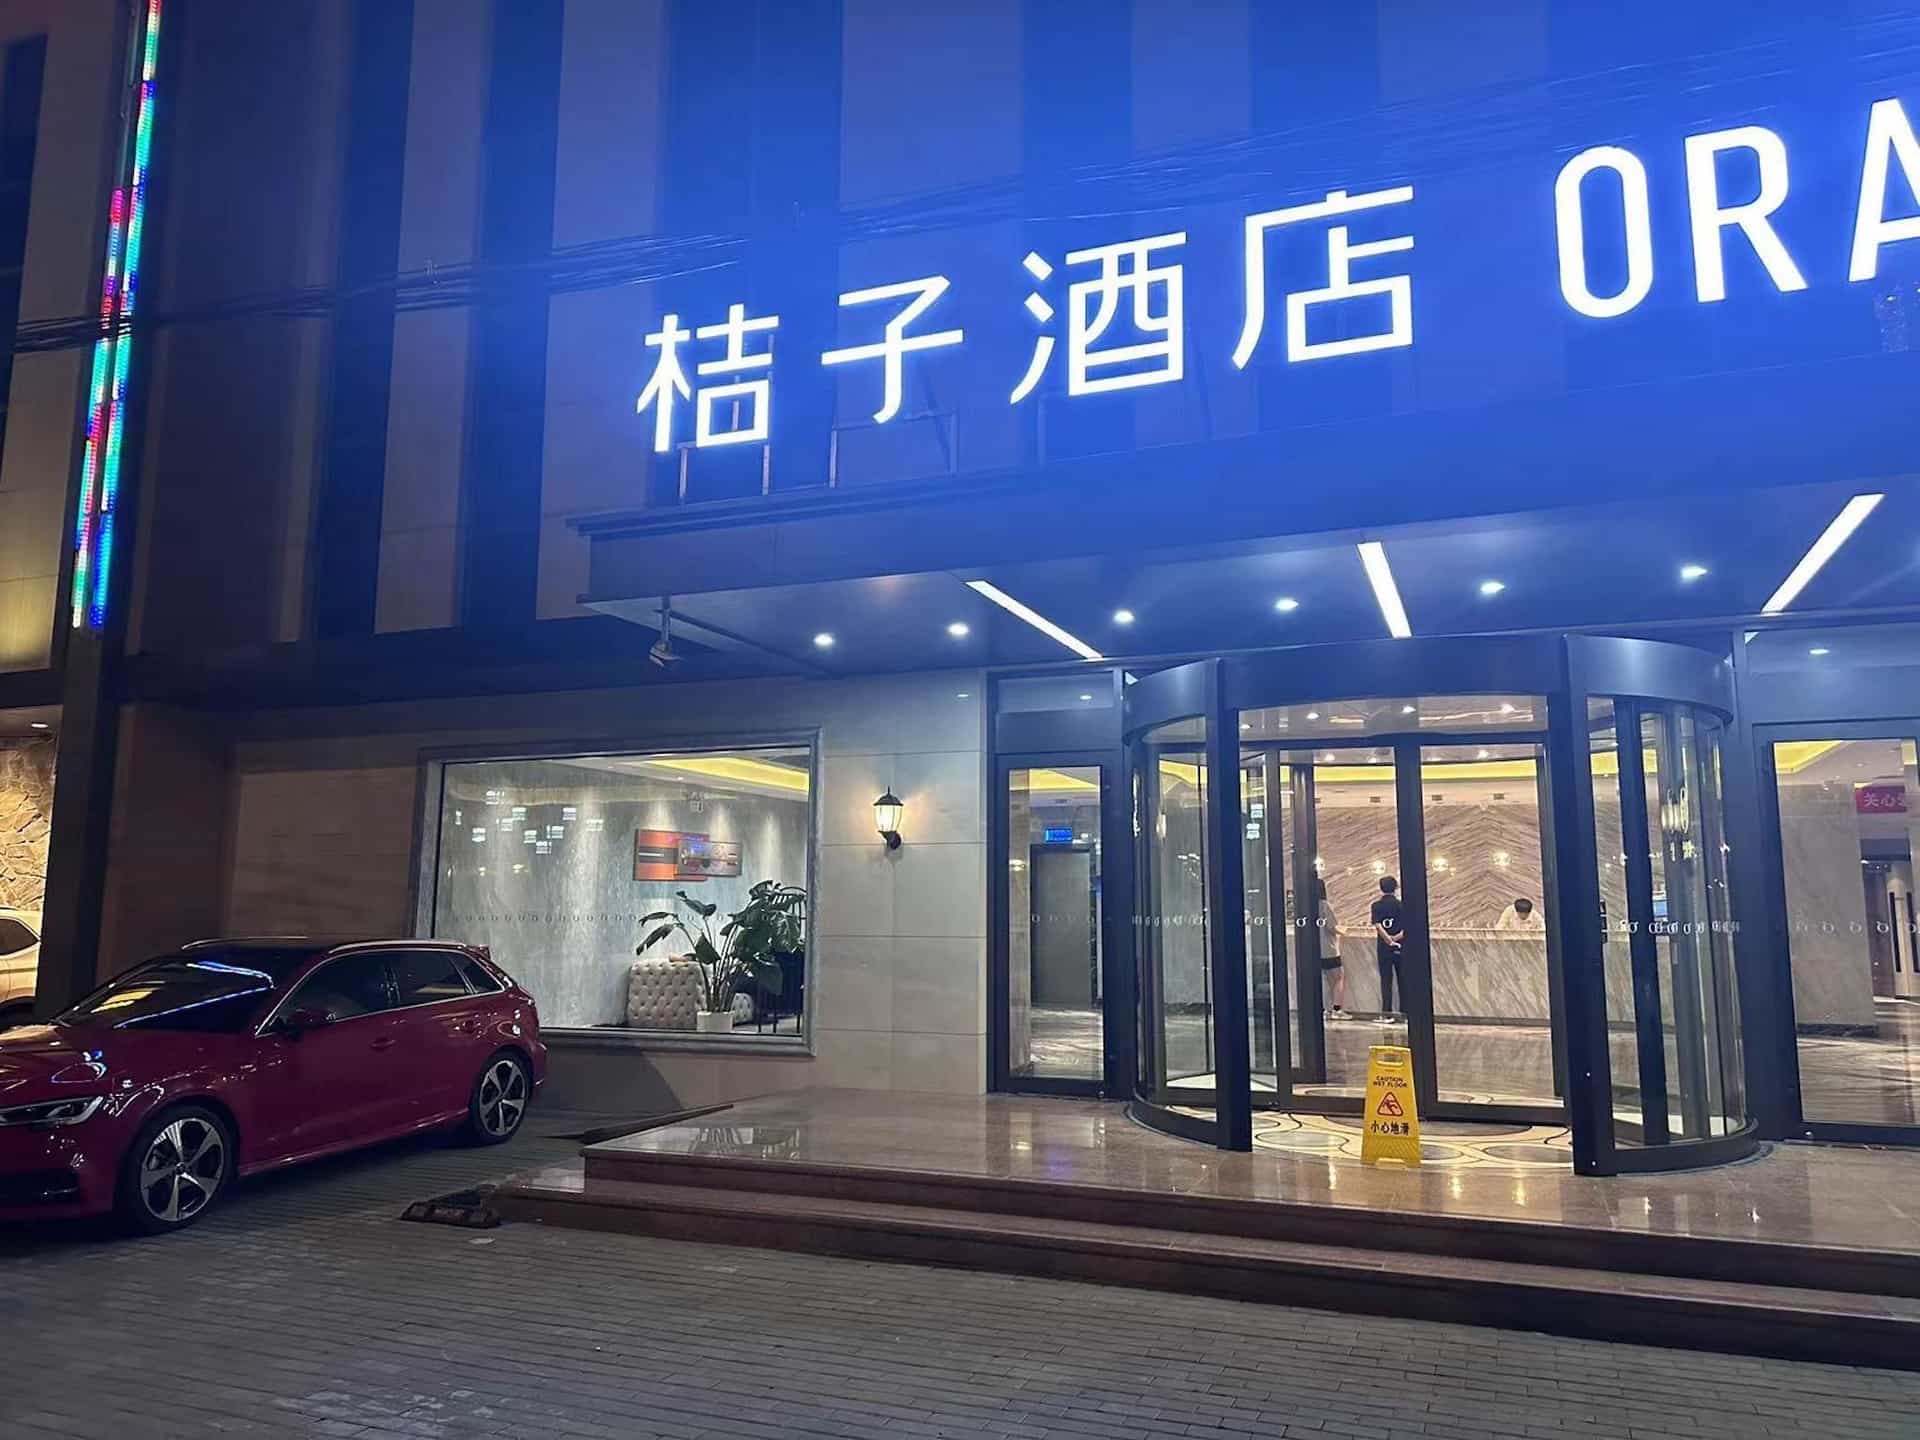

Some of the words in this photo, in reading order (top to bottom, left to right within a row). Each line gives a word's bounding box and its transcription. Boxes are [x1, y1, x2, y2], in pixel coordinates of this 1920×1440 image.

[636, 185, 1414, 453] 桔子酒店
[1371, 1120, 1410, 1136] 小心地滑
